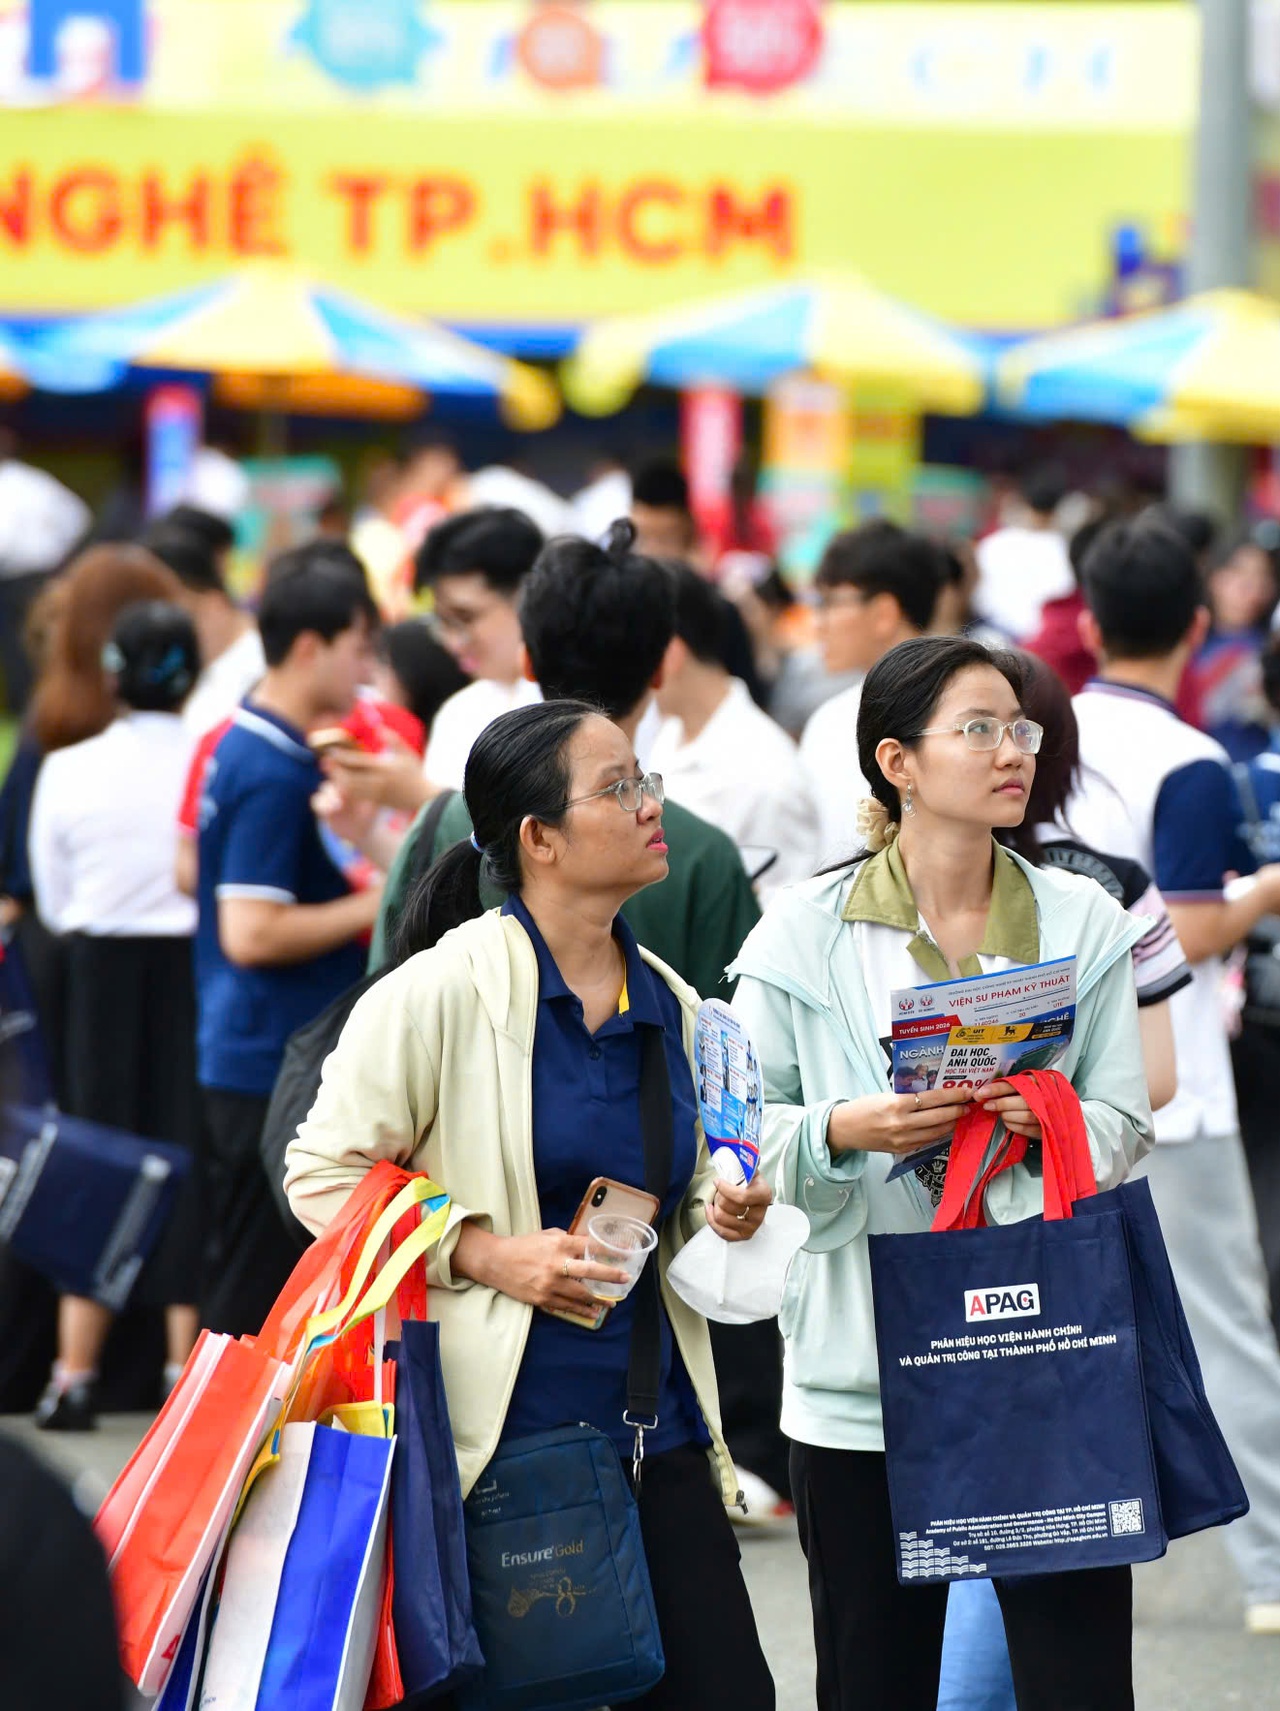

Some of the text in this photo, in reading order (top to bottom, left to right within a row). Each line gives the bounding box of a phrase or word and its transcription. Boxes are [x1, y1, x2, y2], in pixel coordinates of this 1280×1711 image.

[949, 996, 973, 1008] VIỆN
[991, 987, 1021, 1000] PHẠM
[1024, 982, 1038, 993] KỸ
[1040, 975, 1070, 989] THUẬT
[900, 1045, 944, 1060] NGÀNH
[947, 1055, 997, 1067] ANH QUỐC
[951, 1048, 989, 1058] ĐẠI HỌC
[970, 1290, 1034, 1316] APAG
[931, 1325, 1082, 1349] PHÂN HIỆU HỌC VIỆN HÀNH CHÍNH
[899, 1335, 1117, 1366] VÀ QUẢN TRỊ CÔNG TẠI THÀNH PHỐ HỒ CHÍ MINH
[555, 1540, 583, 1557] Gold
